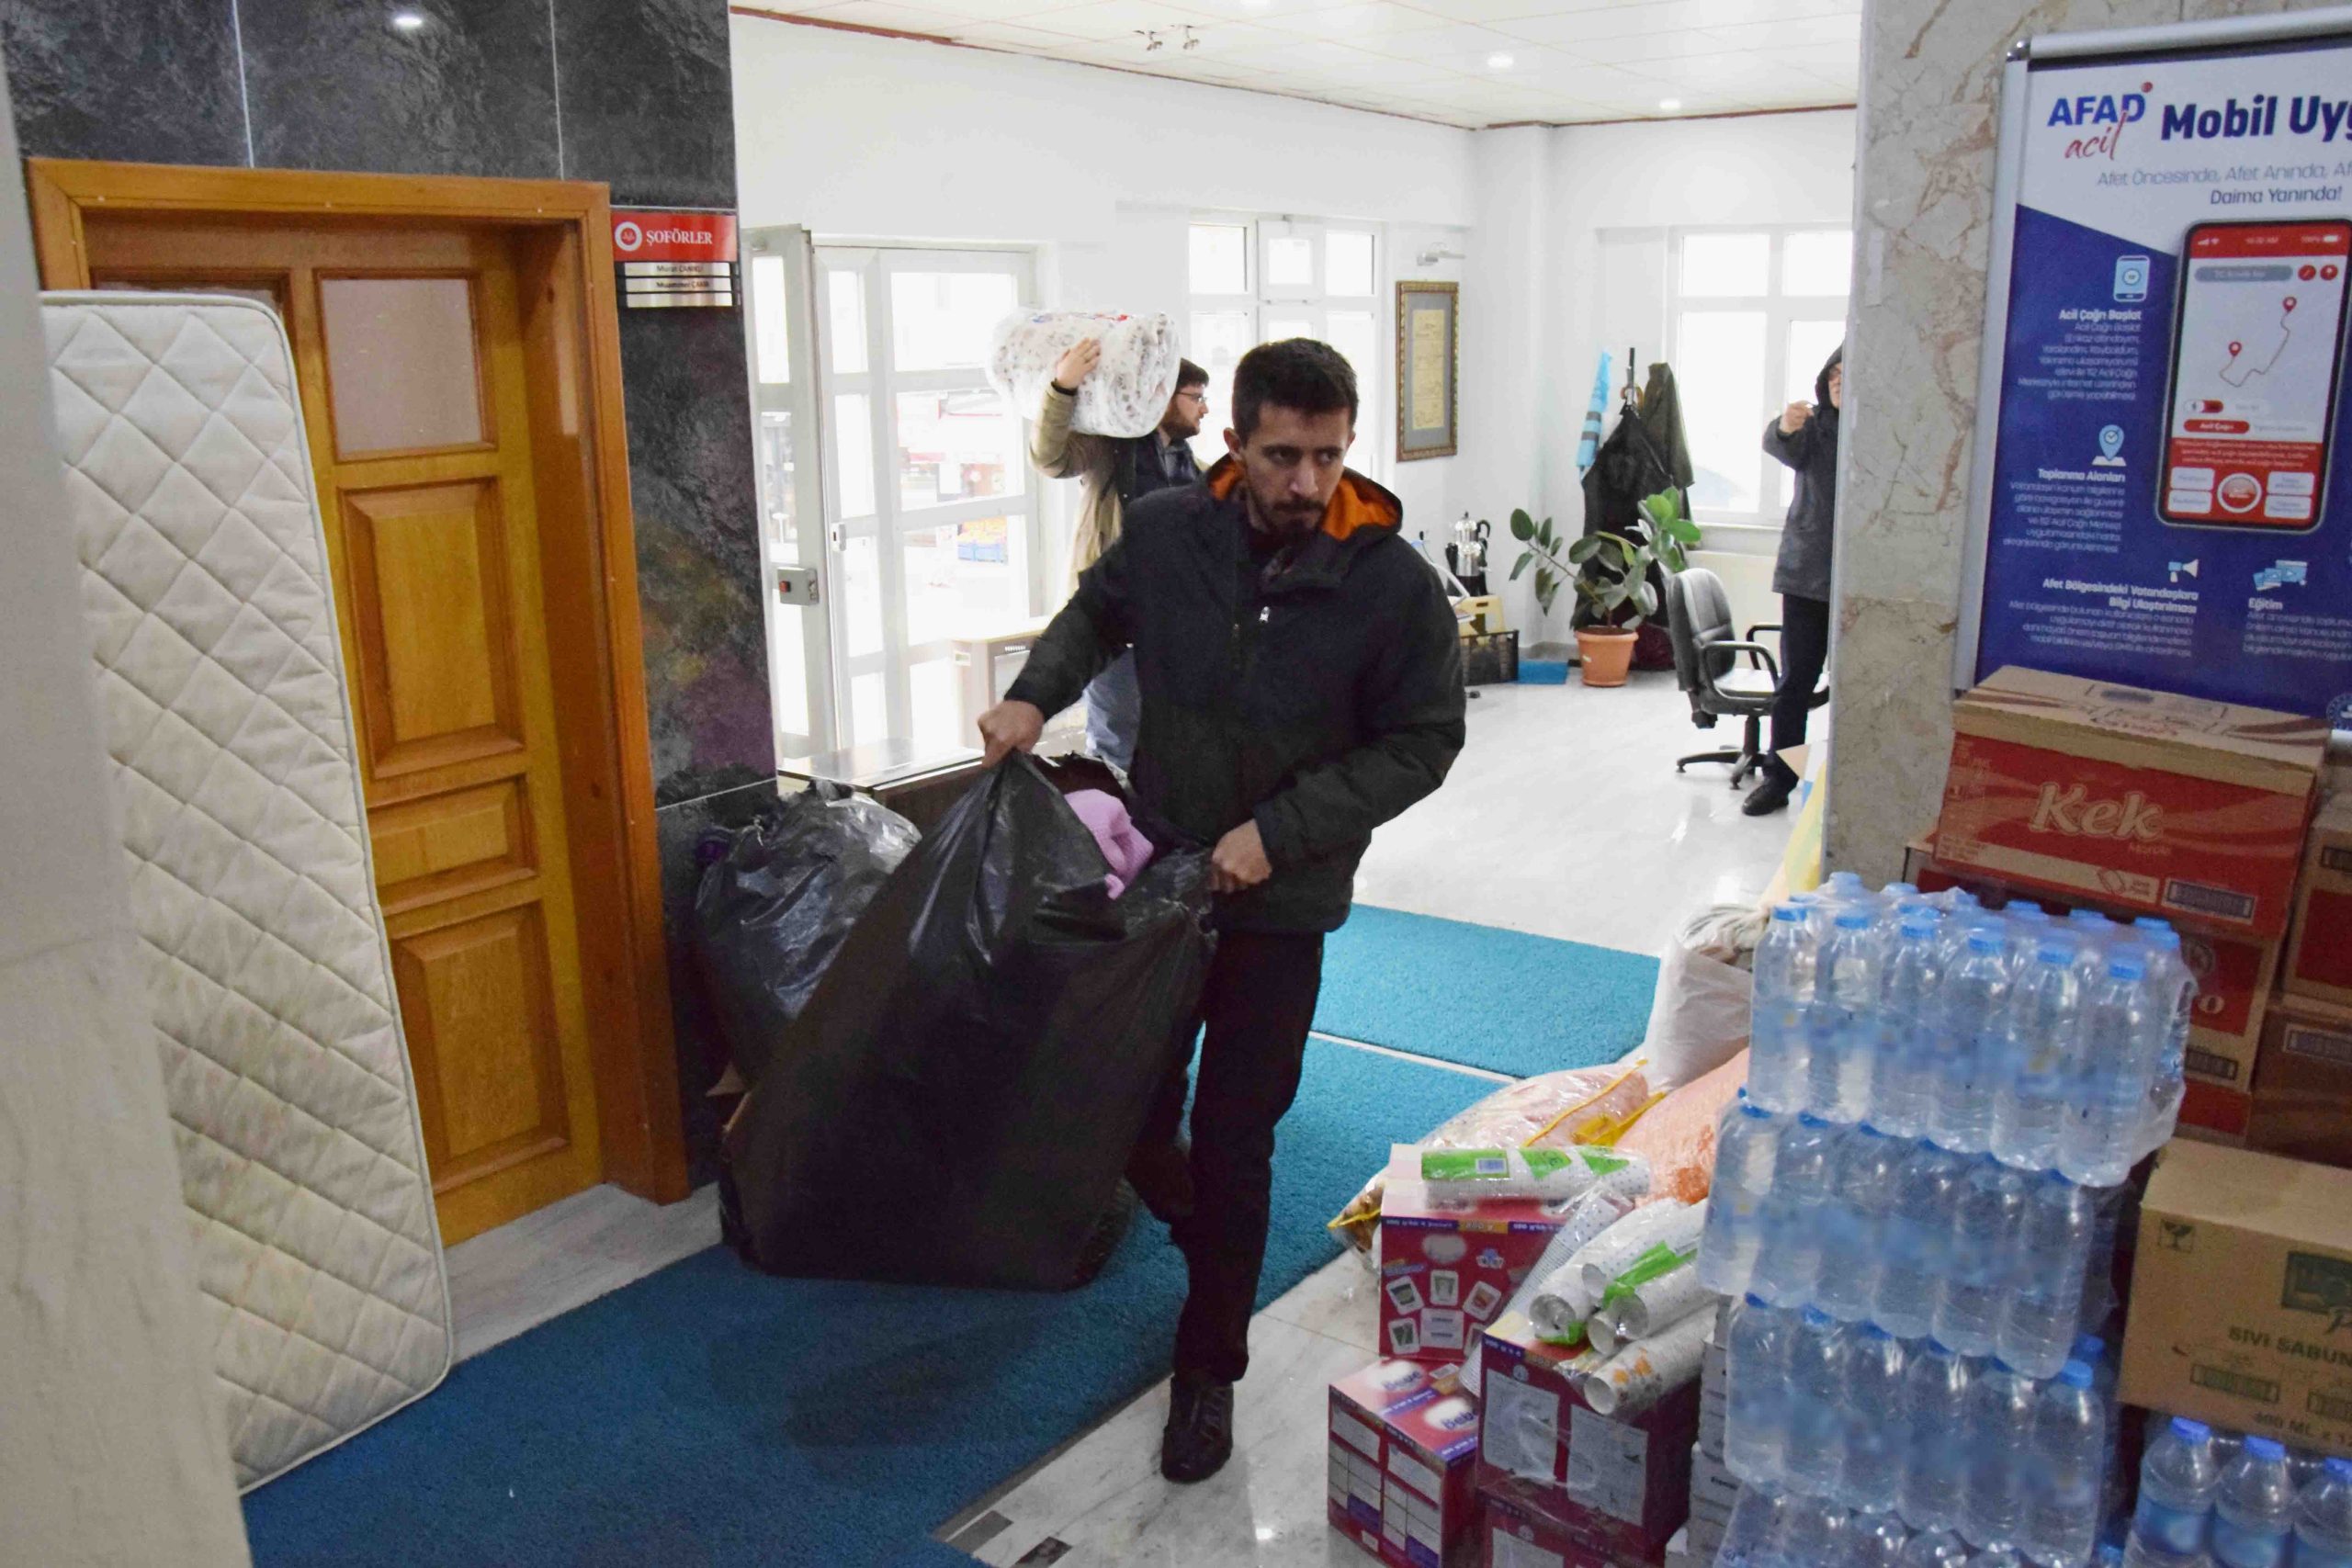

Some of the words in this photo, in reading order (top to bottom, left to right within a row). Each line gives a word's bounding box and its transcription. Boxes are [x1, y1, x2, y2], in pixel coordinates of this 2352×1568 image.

[2047, 94, 2147, 127] AFAD
[2161, 94, 2278, 141] Mobil
[2289, 95, 2352, 143] Uy
[2064, 111, 2129, 162] acil
[2097, 171, 2129, 186] Afet
[2225, 164, 2259, 182] Afet
[2210, 188, 2264, 205] Daima
[2267, 186, 2343, 204] Yanında!
[645, 228, 713, 246] ŞOFÖRLER
[2059, 309, 2078, 321] Acil
[2038, 468, 2086, 480] Toplanma
[2042, 578, 2064, 590] Afet
[2109, 596, 2132, 611] Bilgi
[2028, 780, 2165, 841] Kek
[2228, 1325, 2270, 1348] SIVI
